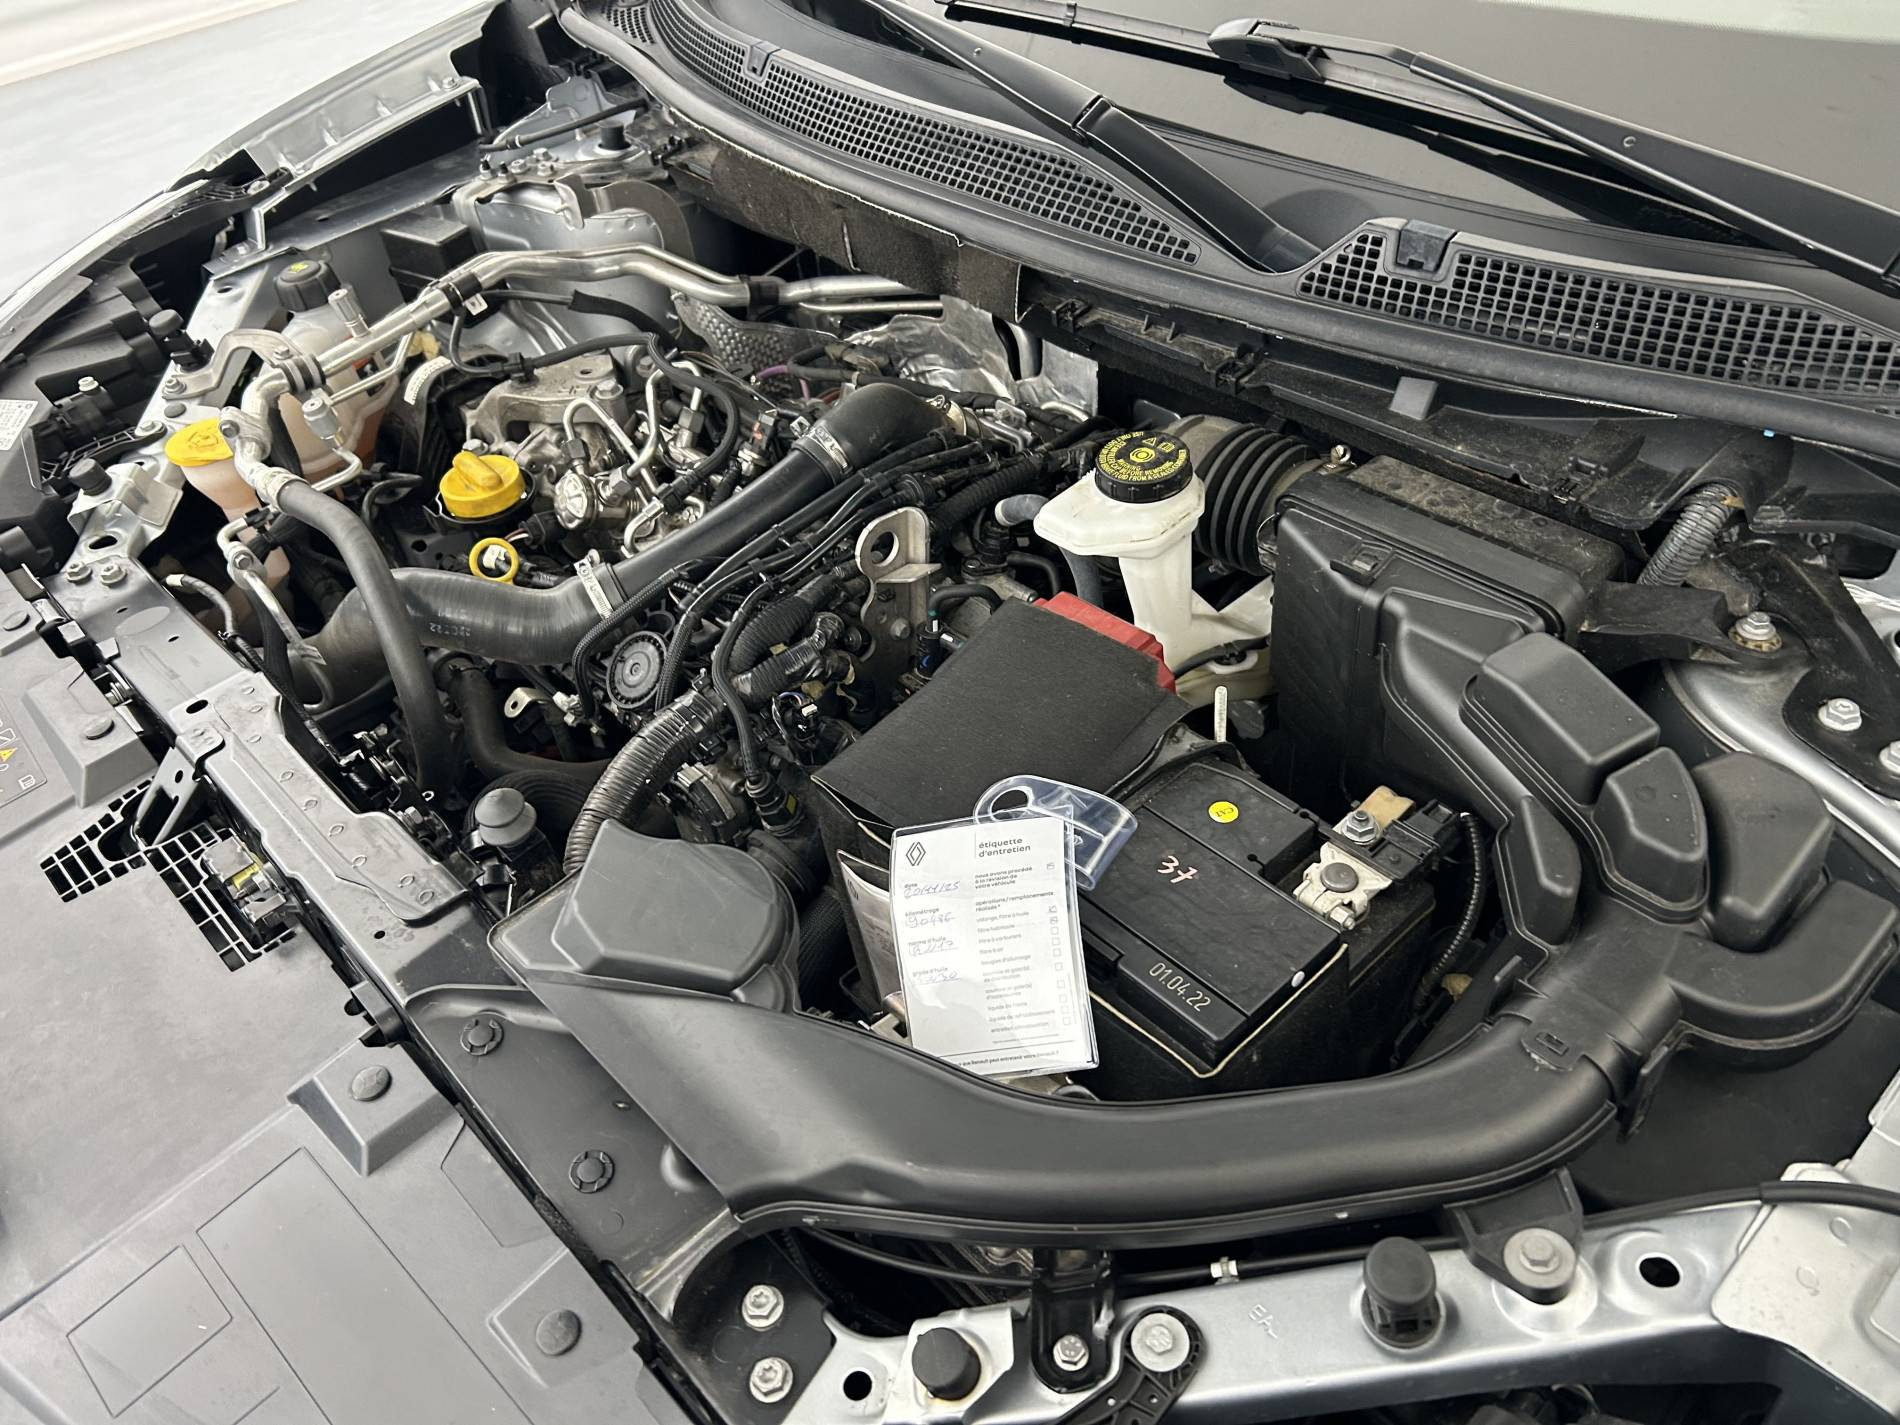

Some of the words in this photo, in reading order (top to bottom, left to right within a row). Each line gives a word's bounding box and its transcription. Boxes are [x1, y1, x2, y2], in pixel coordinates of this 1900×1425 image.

[978, 838, 1023, 849] étiquette
[978, 845, 1031, 858] d'entretien
[1157, 856, 1198, 884] 37
[1149, 962, 1211, 1012] 01.04.22
